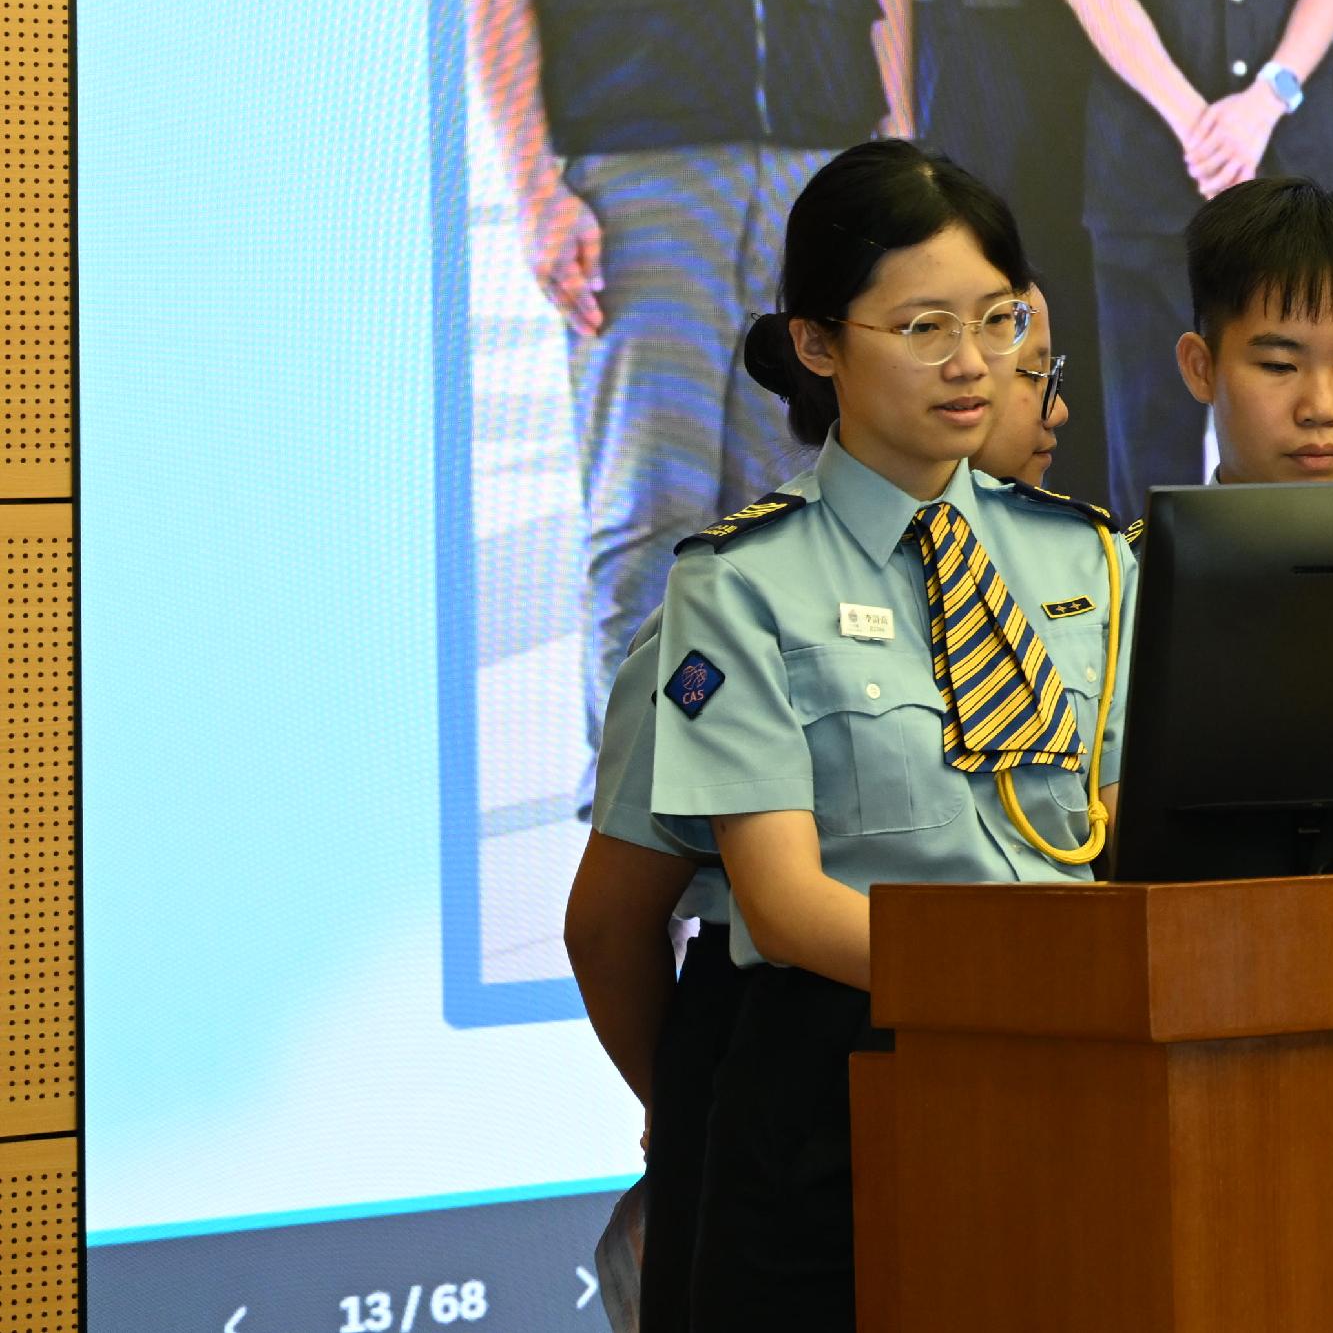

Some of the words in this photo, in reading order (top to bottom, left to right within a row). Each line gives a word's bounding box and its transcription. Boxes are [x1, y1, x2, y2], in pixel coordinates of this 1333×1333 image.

[682, 689, 704, 704] CAS
[338, 1289, 392, 1333] 13
[430, 1279, 487, 1324] 68
